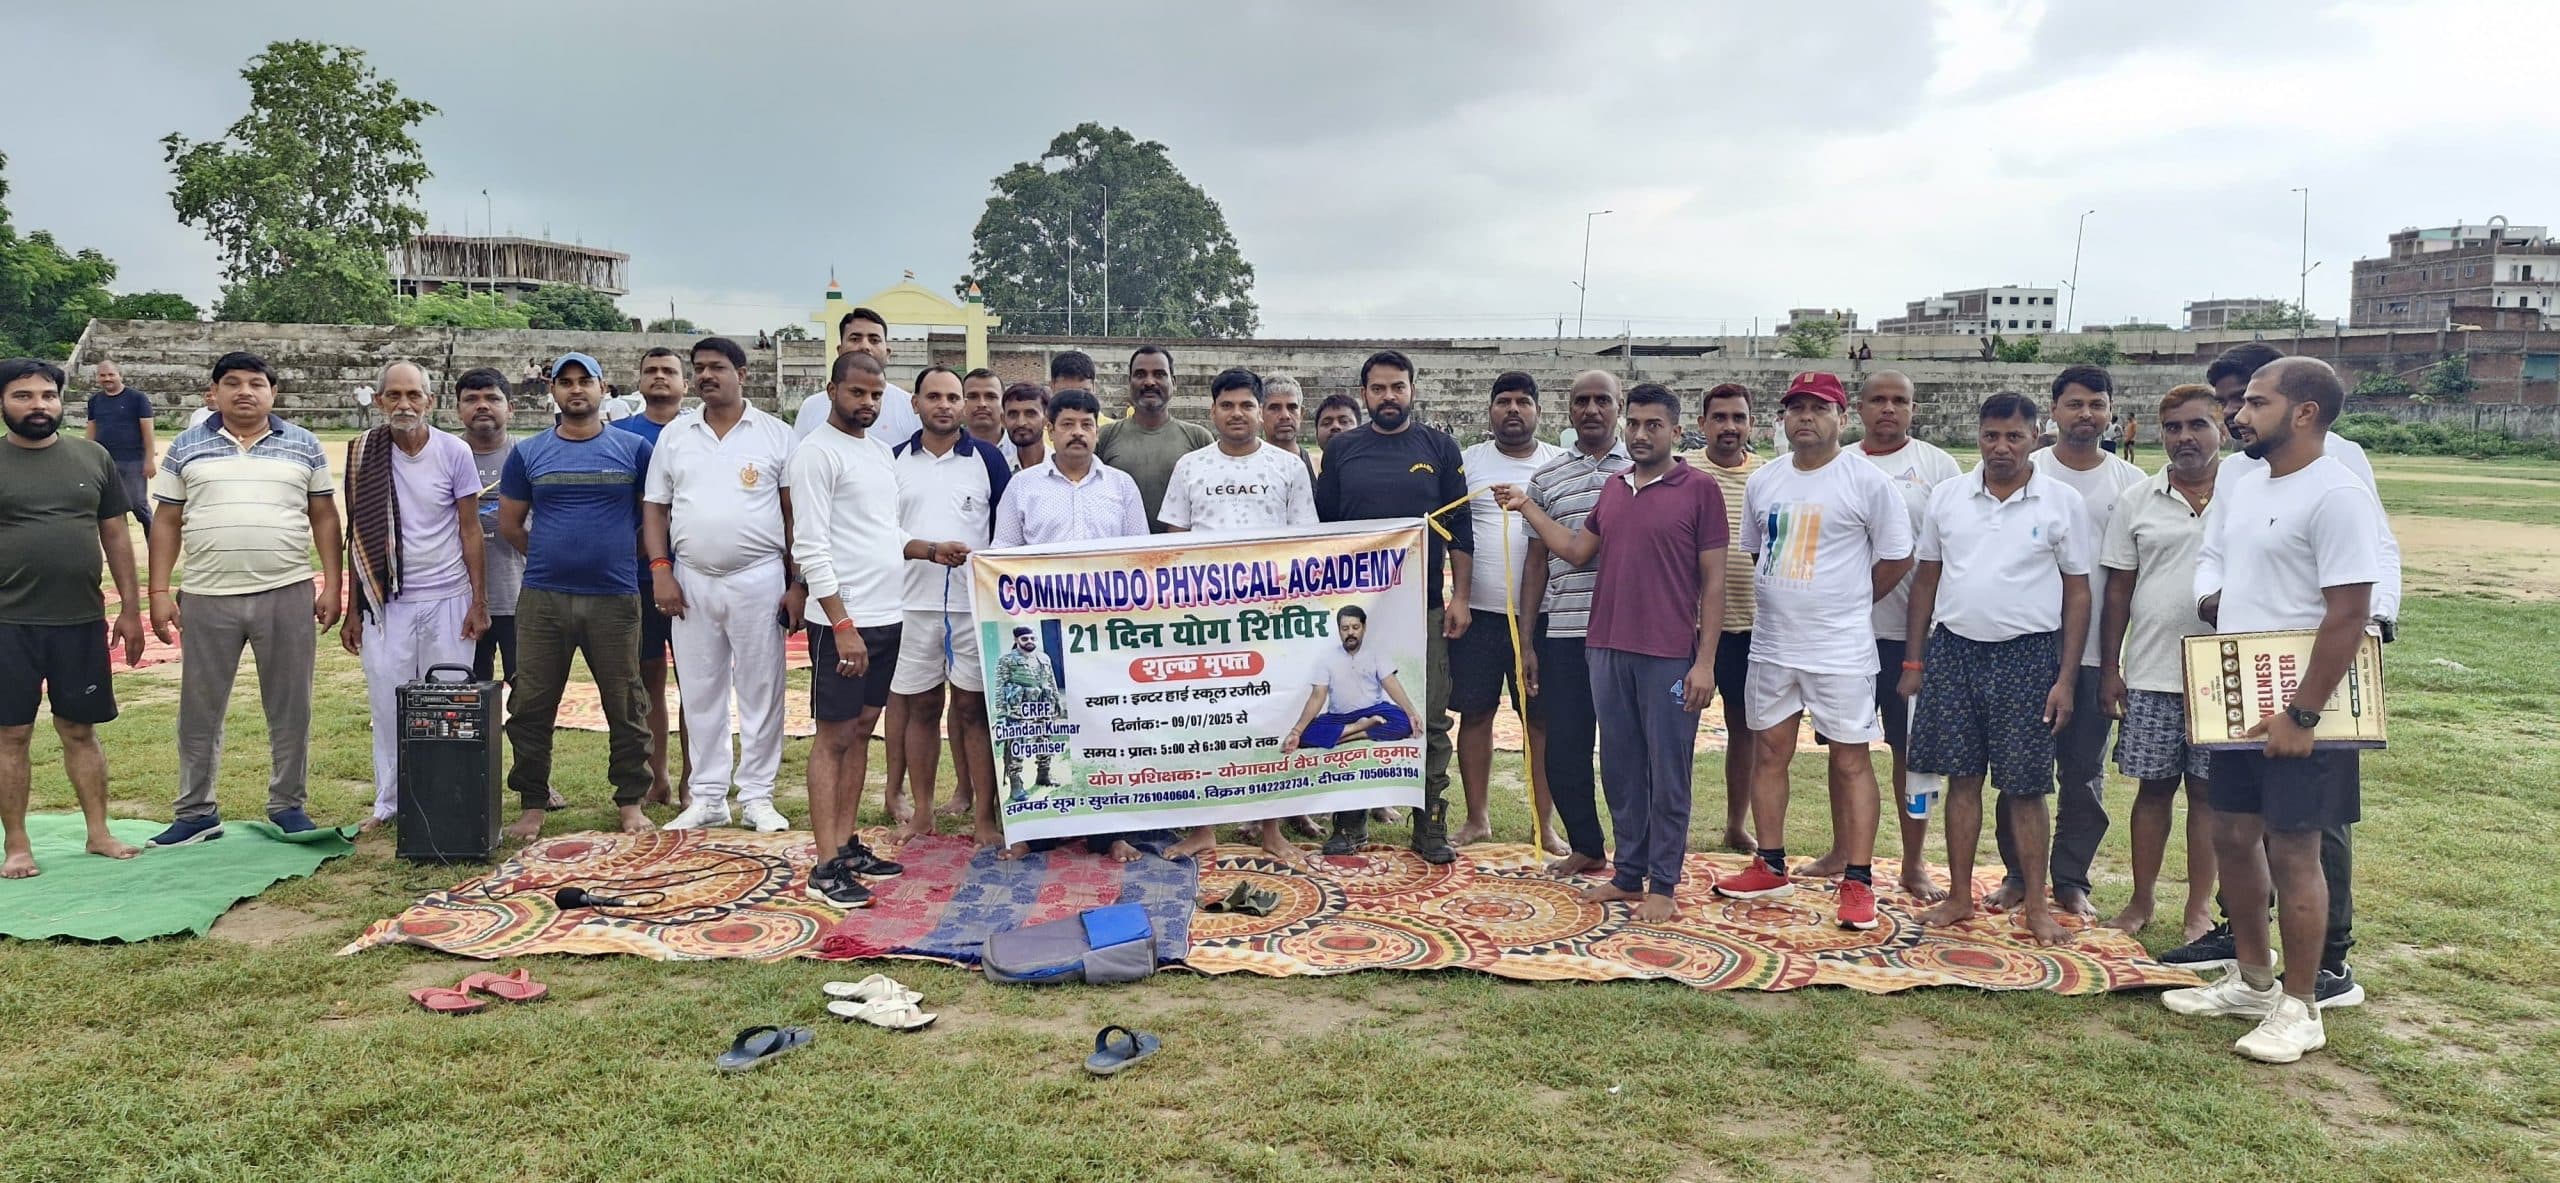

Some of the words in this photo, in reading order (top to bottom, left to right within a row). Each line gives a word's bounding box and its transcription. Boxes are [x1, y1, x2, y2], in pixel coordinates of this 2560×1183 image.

[1206, 485, 1269, 495] LEGACY
[999, 568, 1150, 612] COMMANDO
[1156, 559, 1283, 606] PHYSICAL
[1288, 547, 1408, 594] ACADEMY
[1069, 623, 1098, 653] 21
[1106, 618, 1163, 650] दिन
[1169, 614, 1231, 646] योग
[1237, 605, 1331, 642] शिविर
[1142, 656, 1198, 681] शुल्क
[1201, 653, 1250, 677] मुफ्त
[1085, 695, 1119, 708] स्थान
[1131, 690, 1163, 706] इन्टर
[1165, 685, 1190, 702] हाई
[1192, 686, 1227, 704] स्कूल
[1229, 681, 1271, 698] रजौली
[1022, 703, 1050, 717] CRPF
[1172, 713, 1232, 730] 09/07/2025
[1236, 711, 1248, 725] से
[995, 723, 1042, 739] Chandan
[1045, 721, 1080, 735] Kumar
[1012, 739, 1066, 758] Organiser
[1083, 747, 1117, 759] समय
[1161, 743, 1185, 756] 5:00
[1188, 740, 1200, 754] से
[1203, 740, 1226, 752] 6:30
[1229, 736, 1252, 750] बजे
[1255, 736, 1279, 748] तक
[1088, 770, 1123, 787] योग
[1218, 754, 1289, 778] योगाचार्य
[1323, 747, 1367, 769] न्यूटन
[1373, 746, 1419, 764] कुमार
[1006, 796, 1048, 816] सम्पर्क
[1052, 798, 1076, 813] सूत्र
[1088, 792, 1130, 810] सुशांत
[1205, 785, 1245, 799] विक्रम
[1318, 770, 1356, 785] दीपक
[1359, 767, 1419, 781] 7050683194
